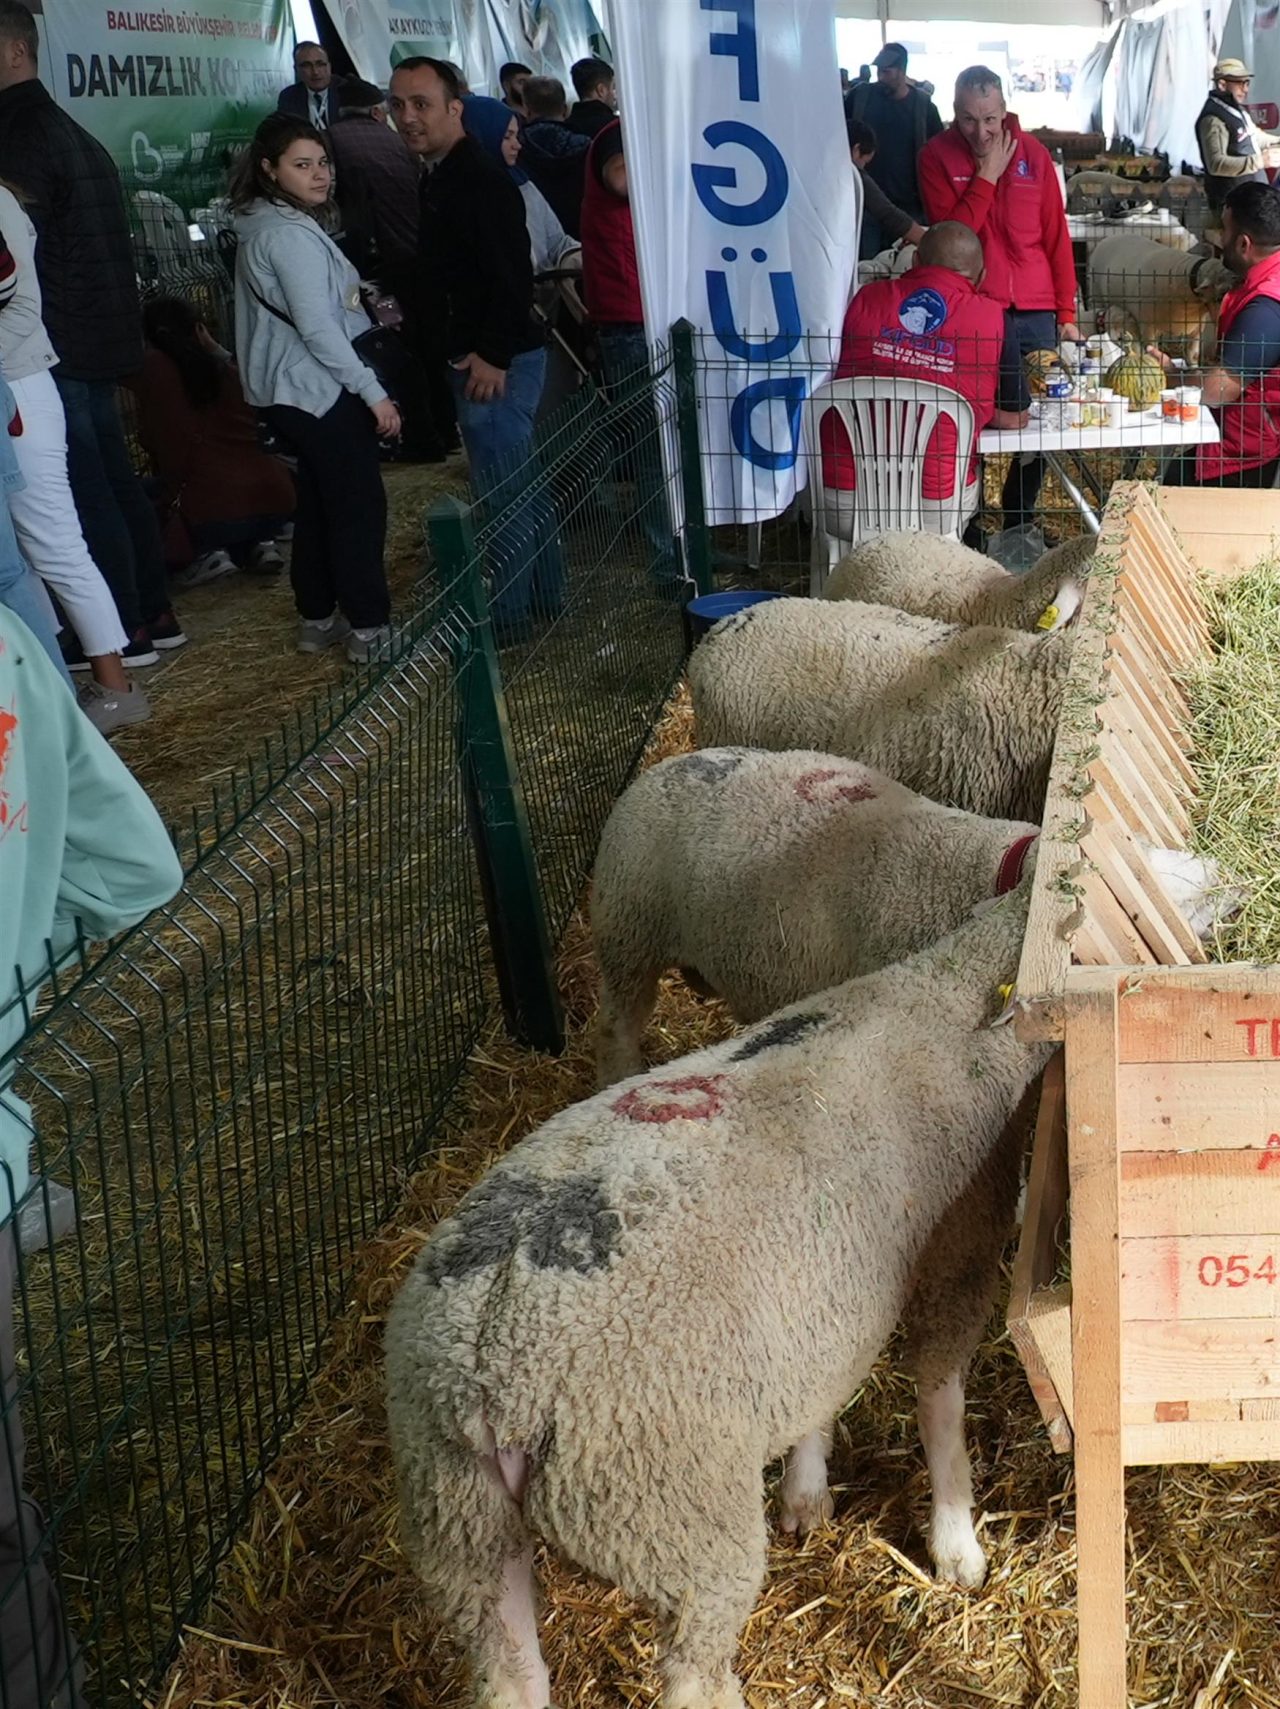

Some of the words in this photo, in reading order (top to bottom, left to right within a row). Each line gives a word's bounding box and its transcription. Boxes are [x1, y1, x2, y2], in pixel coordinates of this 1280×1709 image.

[106, 8, 175, 33] BALIKESİR
[176, 11, 236, 41] BÜYÜKŞEHİR
[67, 53, 207, 97] DAMIZLIK
